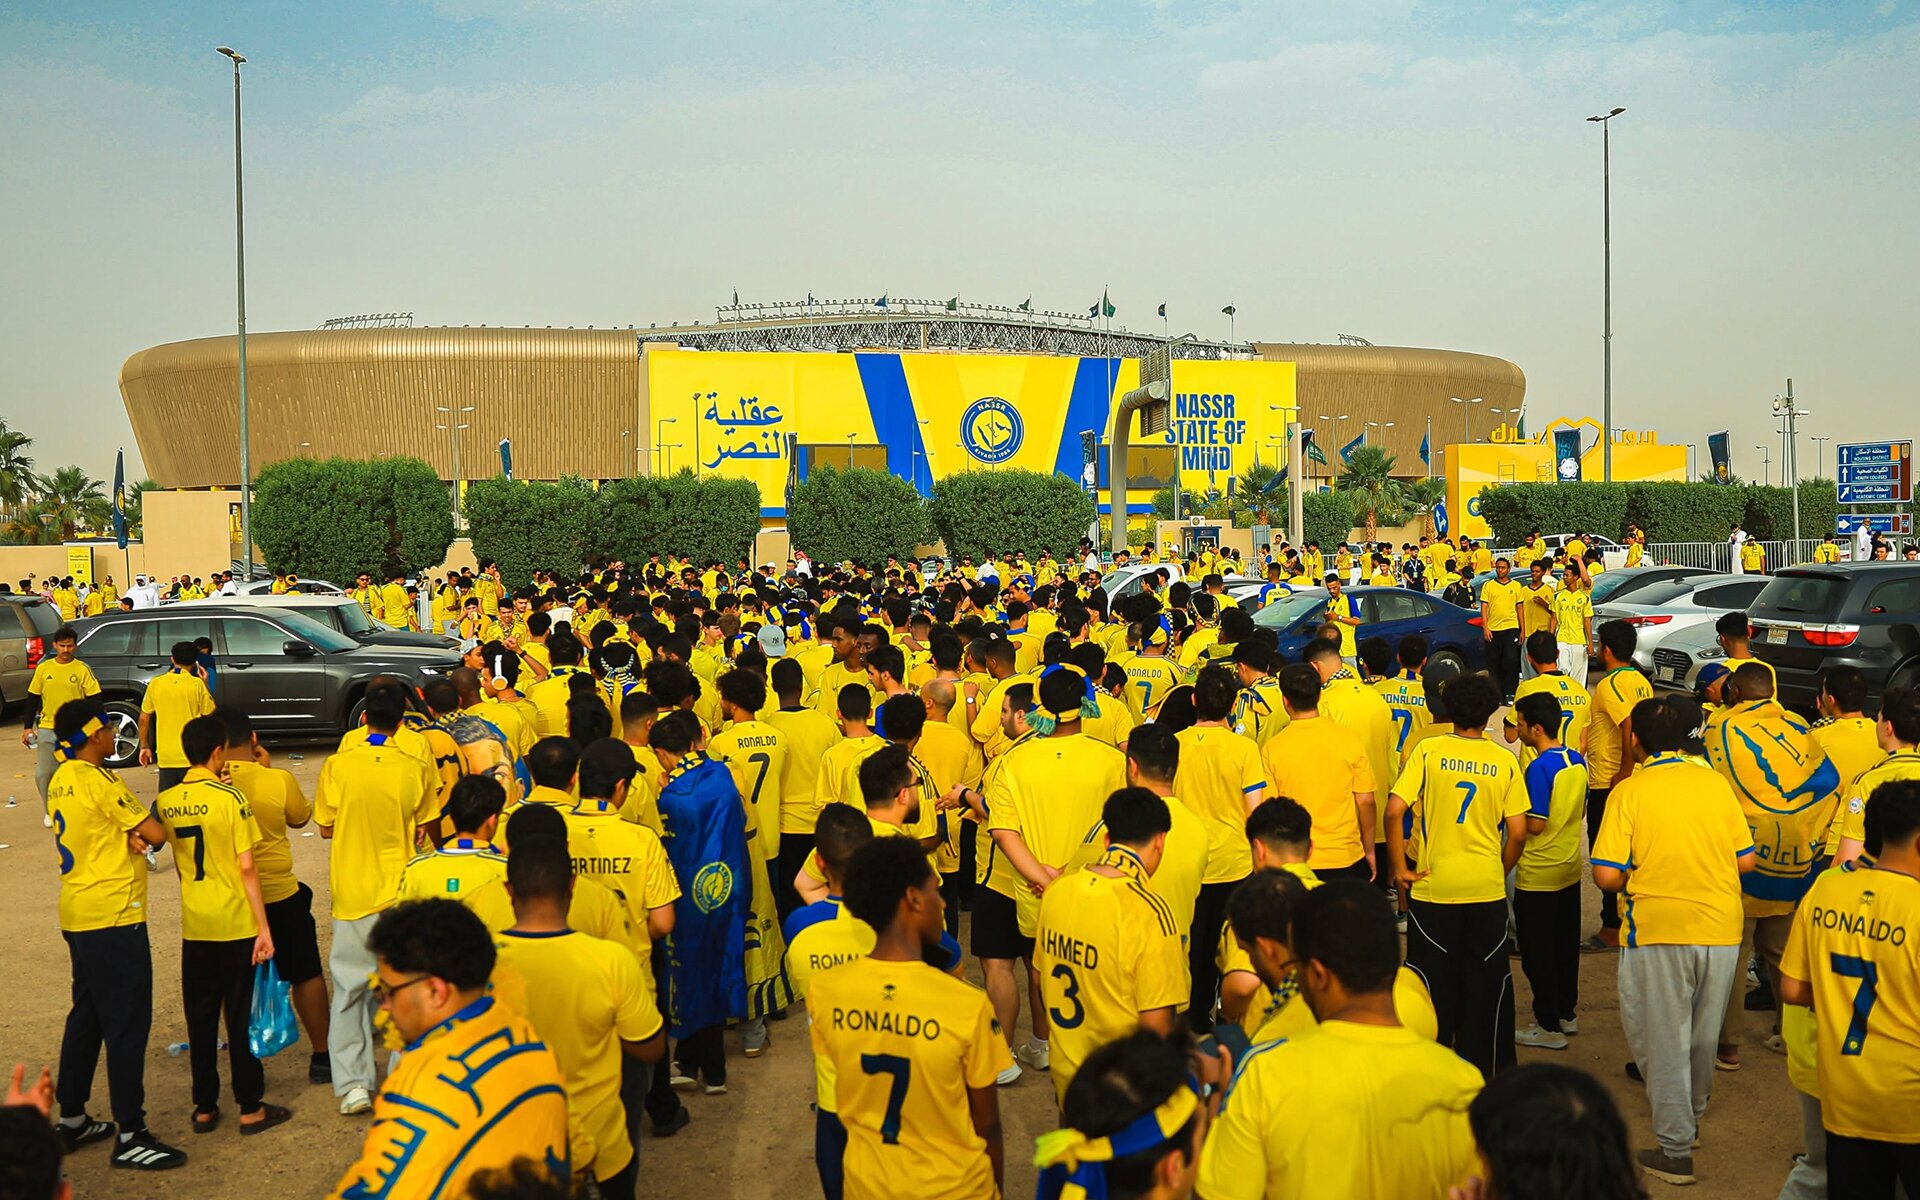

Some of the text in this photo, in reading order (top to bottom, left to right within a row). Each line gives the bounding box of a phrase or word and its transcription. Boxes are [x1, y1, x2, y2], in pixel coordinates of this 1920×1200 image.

[703, 391, 784, 436] عقلية
[977, 401, 1007, 412] NASSR
[1176, 393, 1235, 419] NASSR
[702, 430, 789, 469] النصر
[1165, 420, 1246, 445] STATE OF
[1182, 446, 1231, 470] MIND
[1127, 668, 1162, 679] RONALDO
[1136, 680, 1153, 714] 7
[1557, 695, 1587, 706] NALDO
[737, 735, 778, 749] RONALDO
[1391, 708, 1413, 753] 7
[748, 751, 771, 805] 7
[1440, 757, 1498, 778] RONALDO
[163, 804, 208, 819] RONALDO
[1455, 780, 1478, 825] 7
[173, 824, 206, 882] 7
[570, 856, 632, 875] ARTINEZ
[1812, 906, 1906, 947] RONALDO
[810, 953, 859, 970] RONA
[1049, 962, 1086, 1030] 3
[1829, 951, 1879, 1057] 7
[832, 1007, 941, 1041] RONALDO
[860, 1052, 911, 1145] 7
